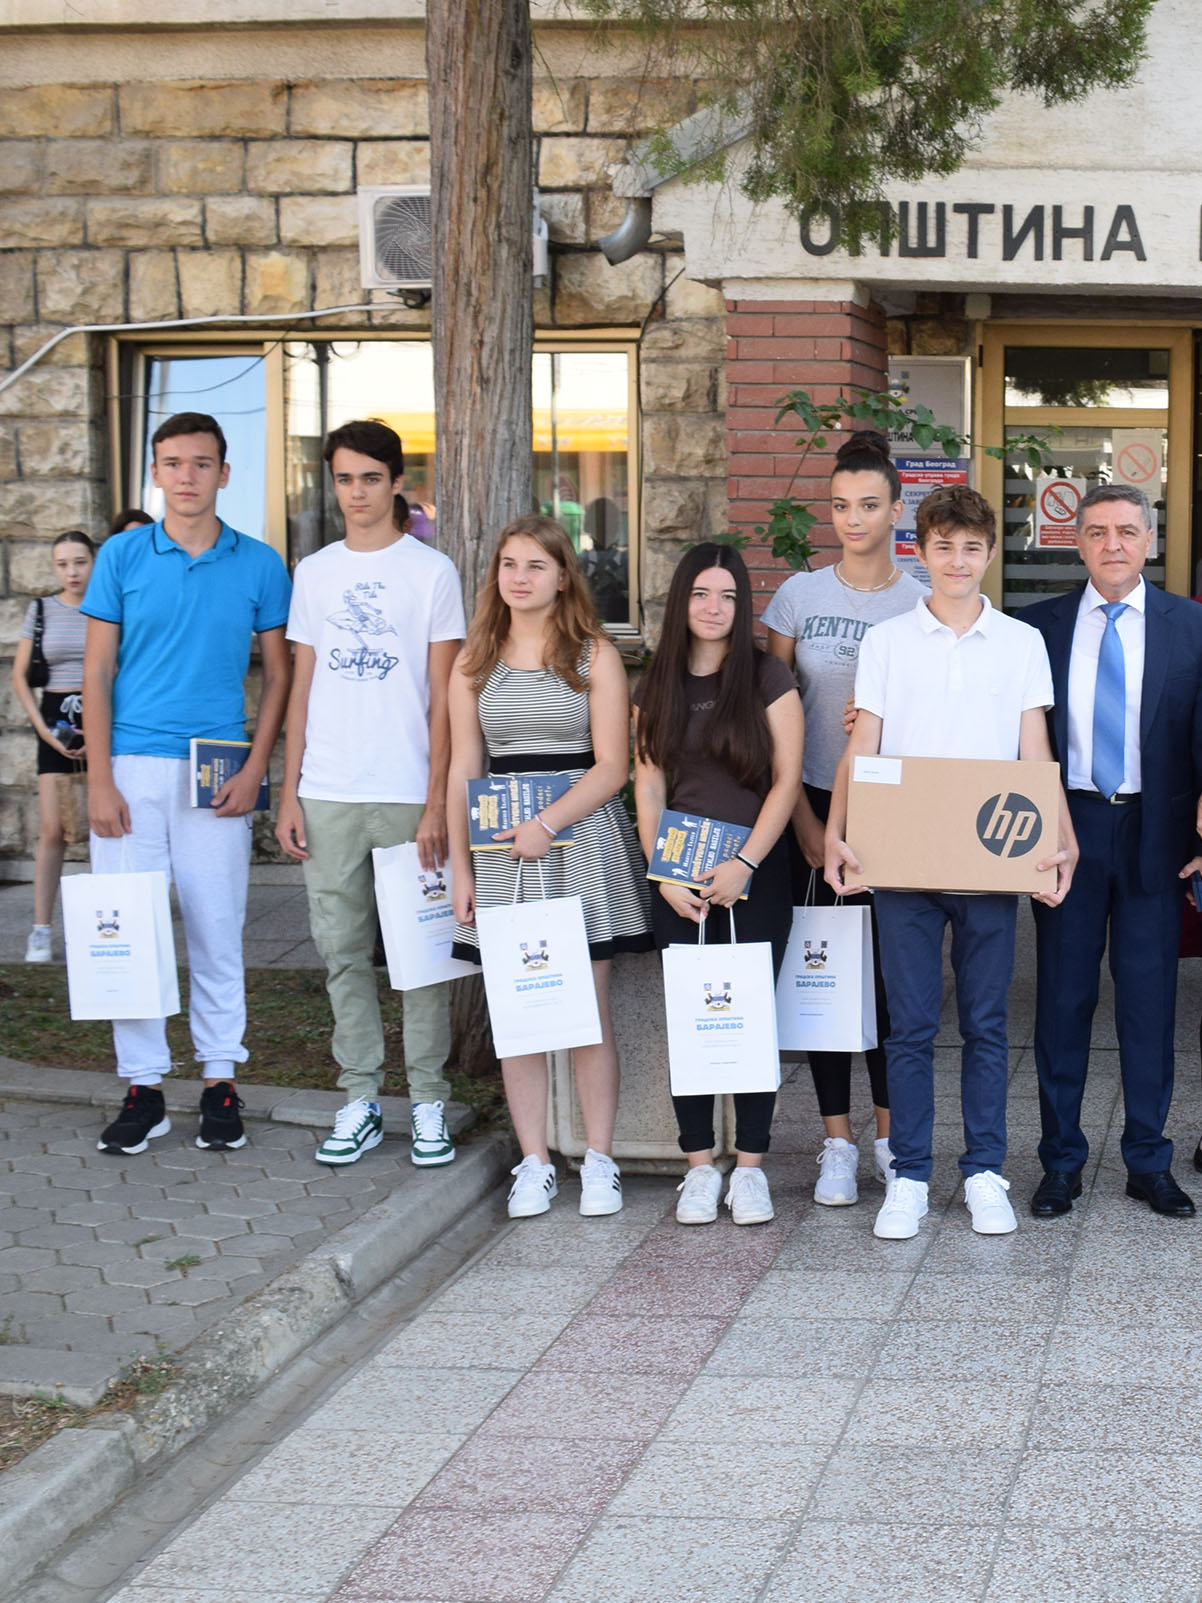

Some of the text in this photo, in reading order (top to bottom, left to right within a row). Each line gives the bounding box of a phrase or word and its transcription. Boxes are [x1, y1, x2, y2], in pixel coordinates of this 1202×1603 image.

[799, 200, 1147, 262] ОПШТИНА
[905, 460, 957, 468] Град Београд
[801, 615, 875, 642] KENTU
[838, 645, 856, 657] 92
[328, 647, 399, 680] Surfing
[982, 792, 1038, 858] hp
[515, 979, 563, 992] БАРАЈЕВО
[696, 1022, 744, 1031] БАРАЈЕВО
